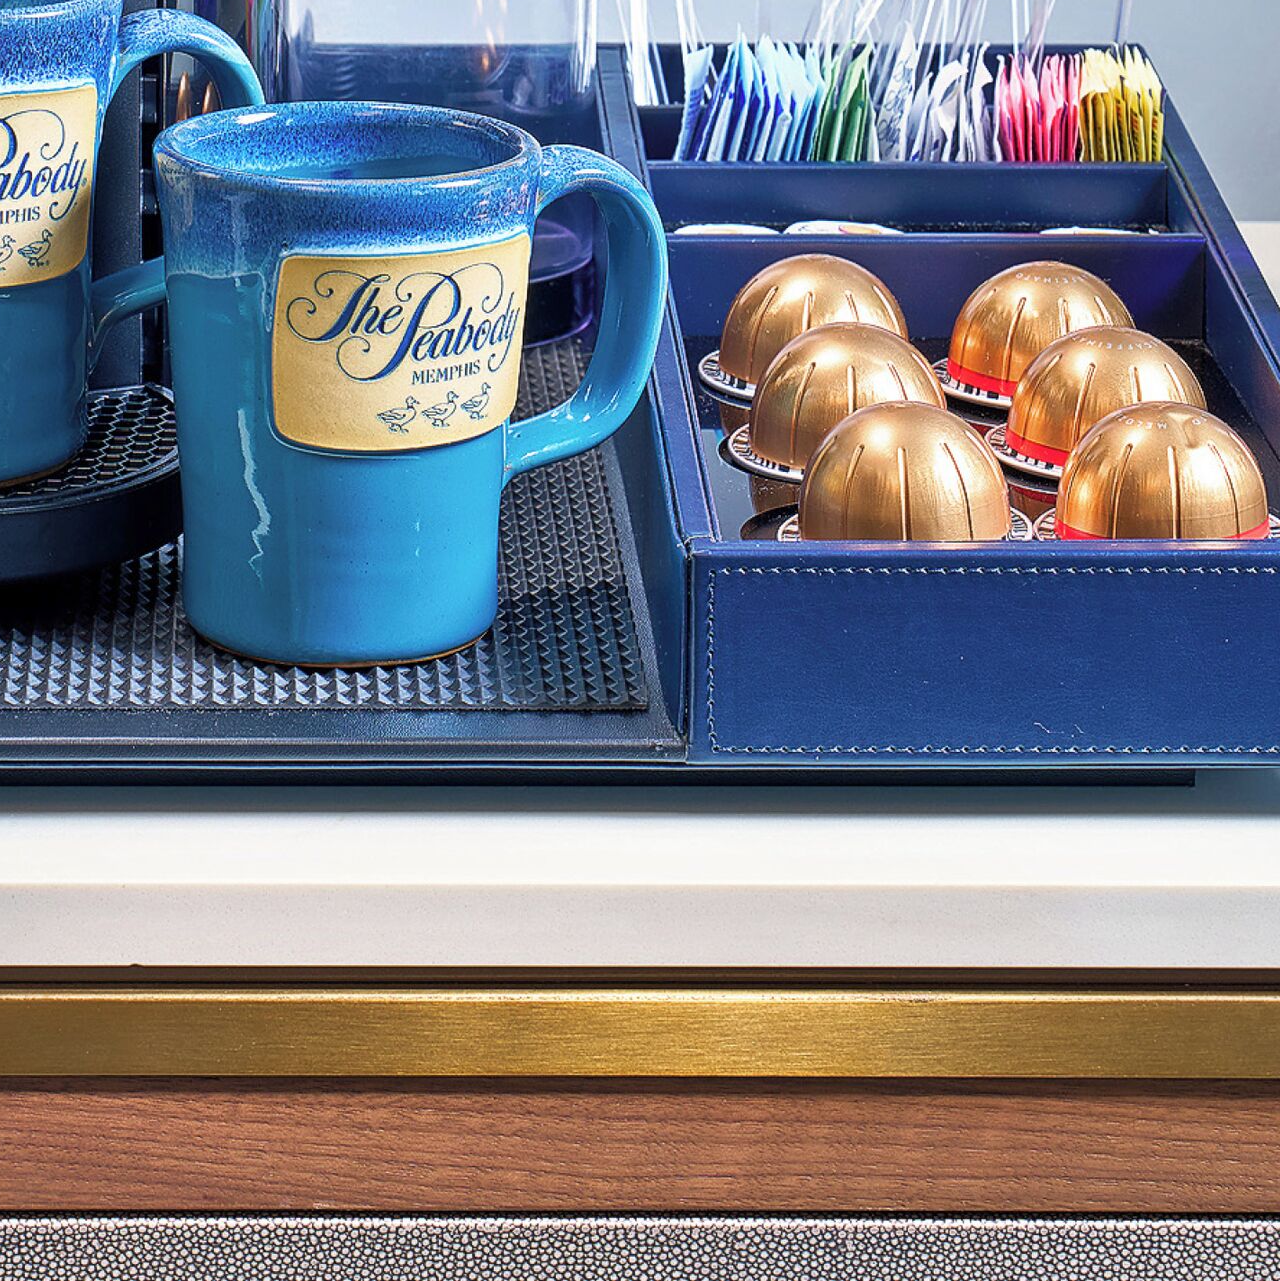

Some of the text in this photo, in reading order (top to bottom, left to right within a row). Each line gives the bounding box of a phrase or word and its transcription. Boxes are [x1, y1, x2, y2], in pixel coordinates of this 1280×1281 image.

[286, 262, 521, 382] The Peabody
[411, 358, 481, 386] MEMPHIS
